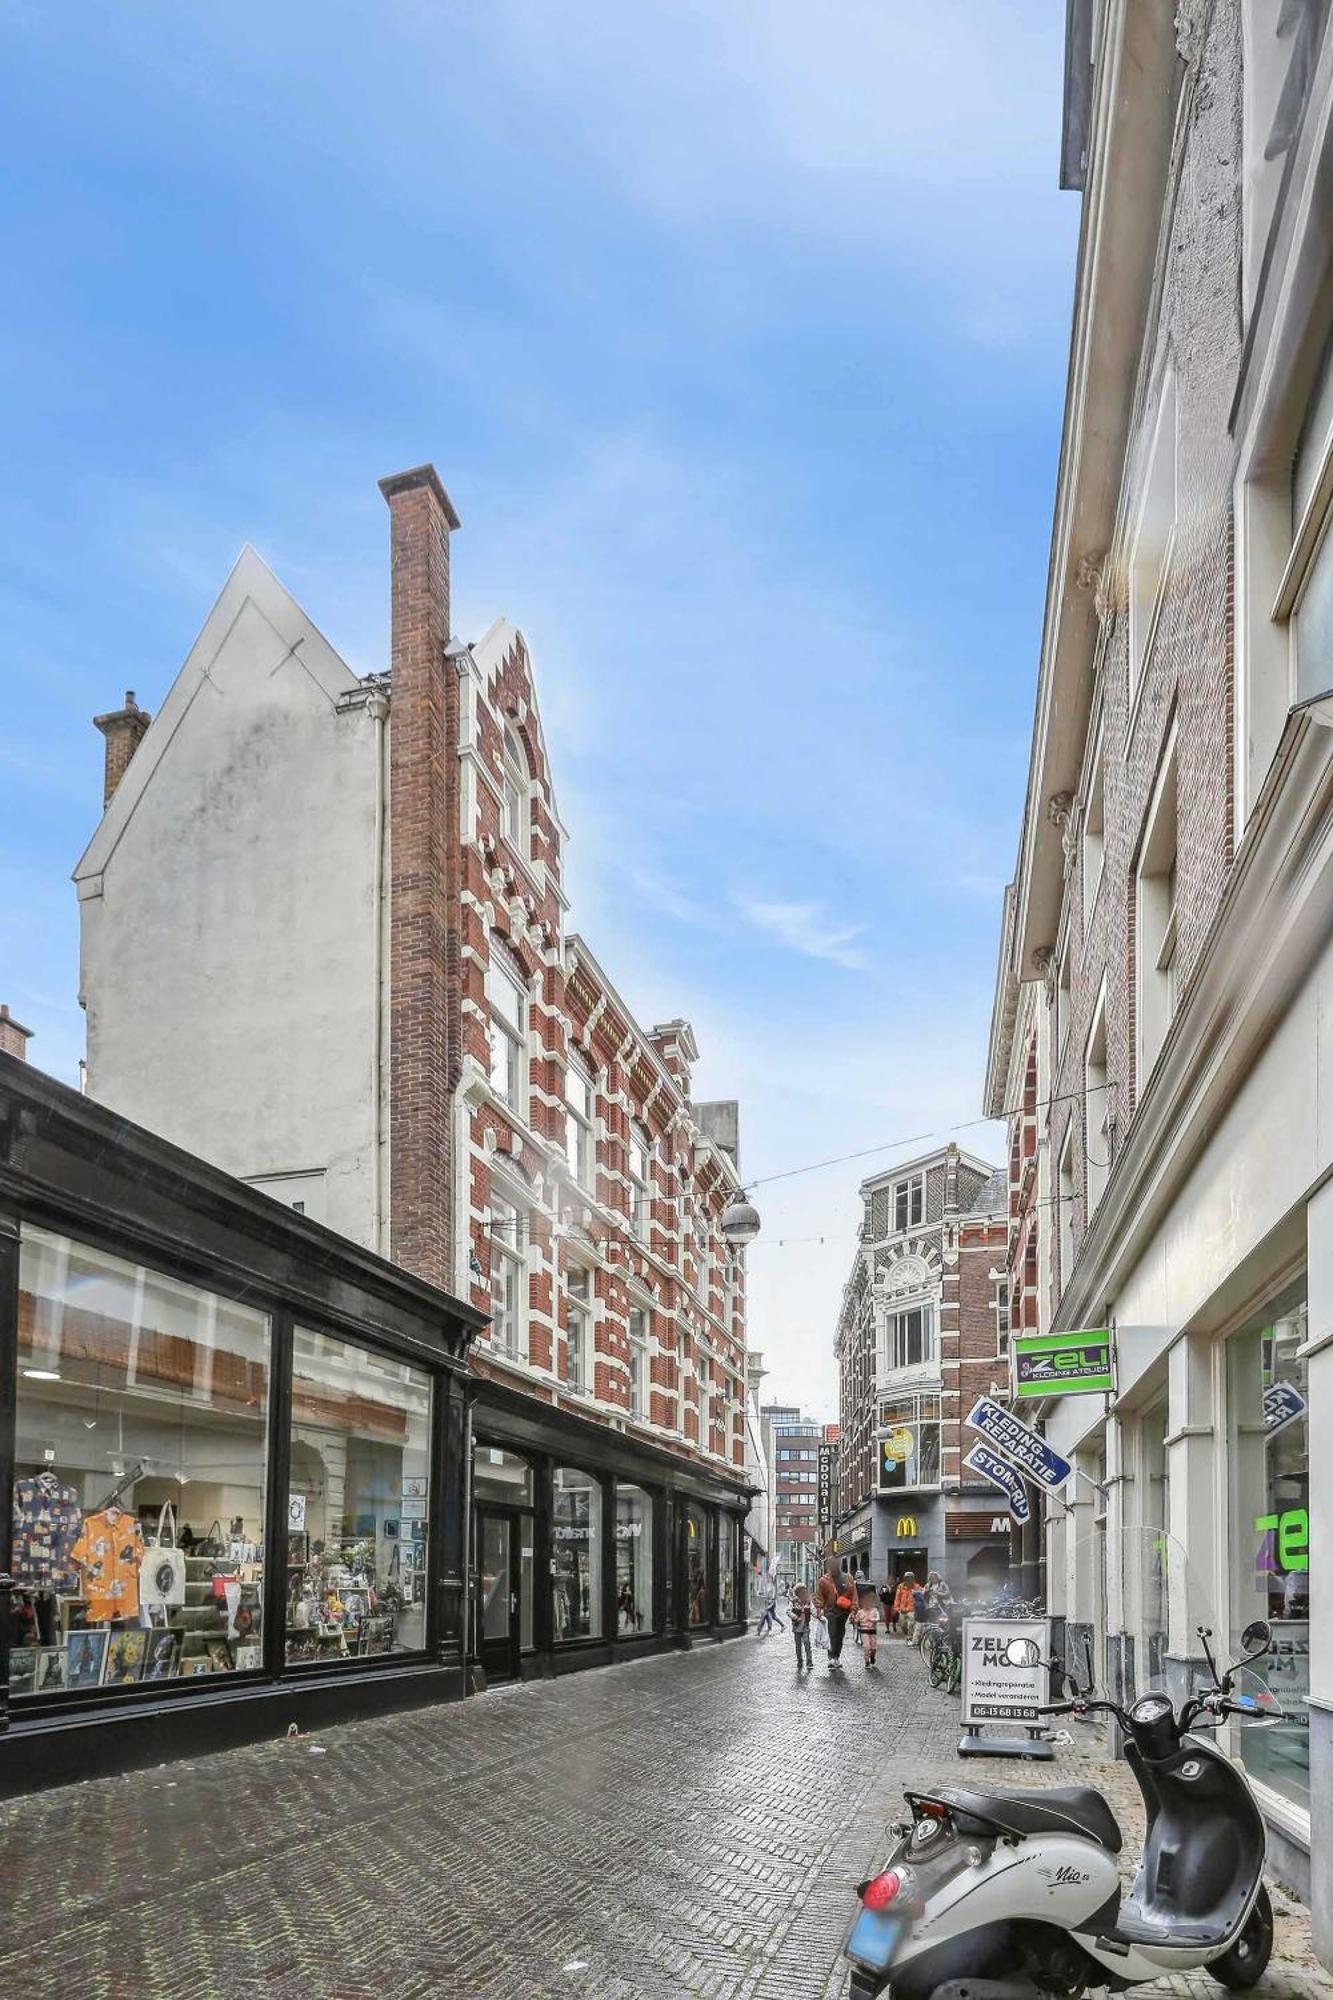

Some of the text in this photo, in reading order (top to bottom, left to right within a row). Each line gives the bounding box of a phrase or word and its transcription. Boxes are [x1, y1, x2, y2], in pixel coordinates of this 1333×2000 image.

[980, 1418, 1056, 1482] REPARATIE
[982, 1404, 1045, 1457] KLEDING-
[1056, 1866, 1081, 1881] Mio
